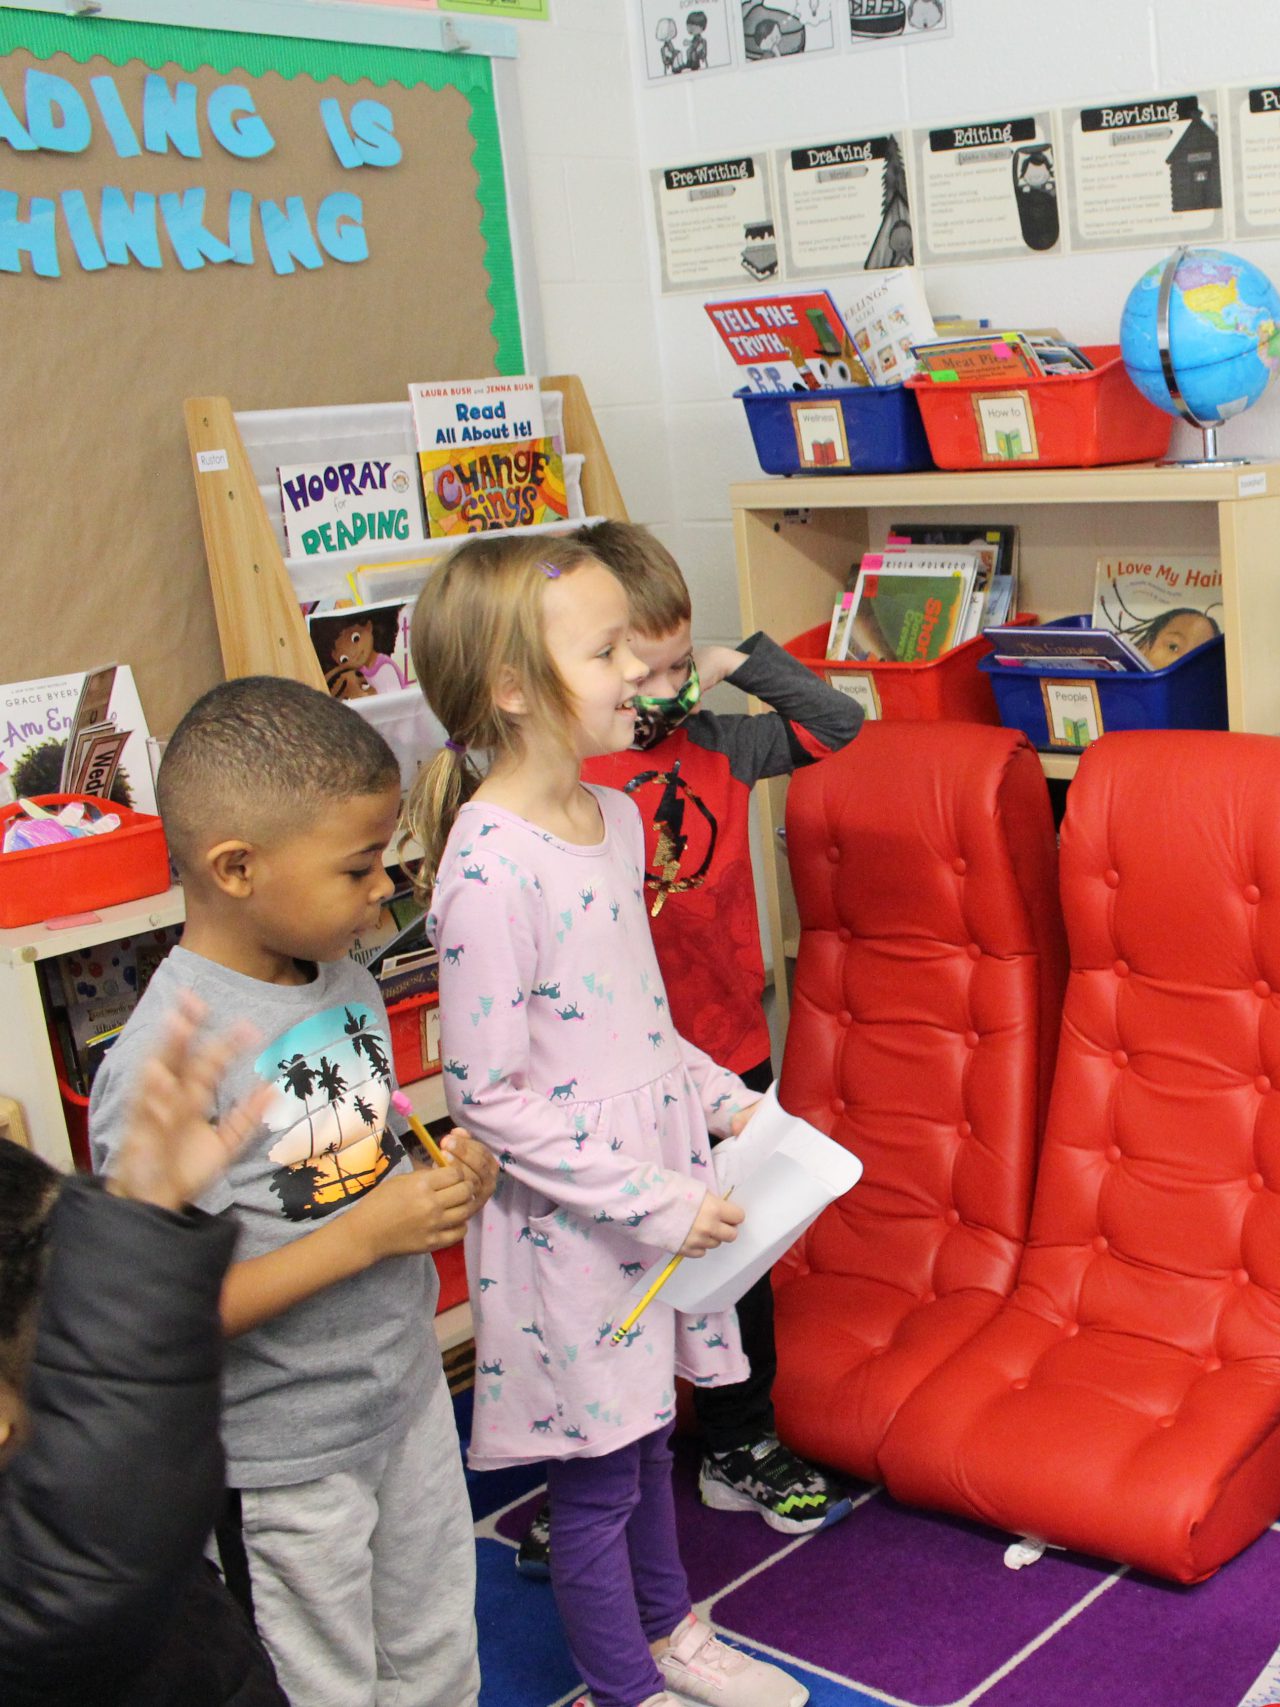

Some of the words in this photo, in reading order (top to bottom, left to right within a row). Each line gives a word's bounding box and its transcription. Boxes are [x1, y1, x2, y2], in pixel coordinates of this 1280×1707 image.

[1101, 101, 1179, 126] Revising
[319, 98, 402, 168] IS
[954, 124, 1013, 146] Editing
[807, 142, 872, 166] Drafting
[671, 161, 749, 187] Pre-Writing
[712, 307, 760, 334] TELL
[755, 304, 799, 328] THE
[420, 388, 448, 398] LAURA
[450, 386, 472, 396] BUSH
[486, 383, 512, 393] JENNA
[514, 382, 534, 391] BUSH
[456, 401, 506, 422] Read
[988, 408, 1009, 418] How
[1010, 407, 1021, 416] to
[435, 427, 456, 444] All
[461, 426, 510, 442] About
[513, 420, 533, 437] It!
[283, 461, 392, 511] HOORAY
[333, 496, 348, 512] for
[301, 508, 410, 555] READING
[1107, 564, 1112, 579] I
[1118, 561, 1153, 576] Love
[1155, 564, 1180, 586] My
[5, 694, 42, 707] GRACE
[47, 688, 79, 701] BYERS
[1055, 691, 1088, 703] People
[3, 721, 44, 748] Am
